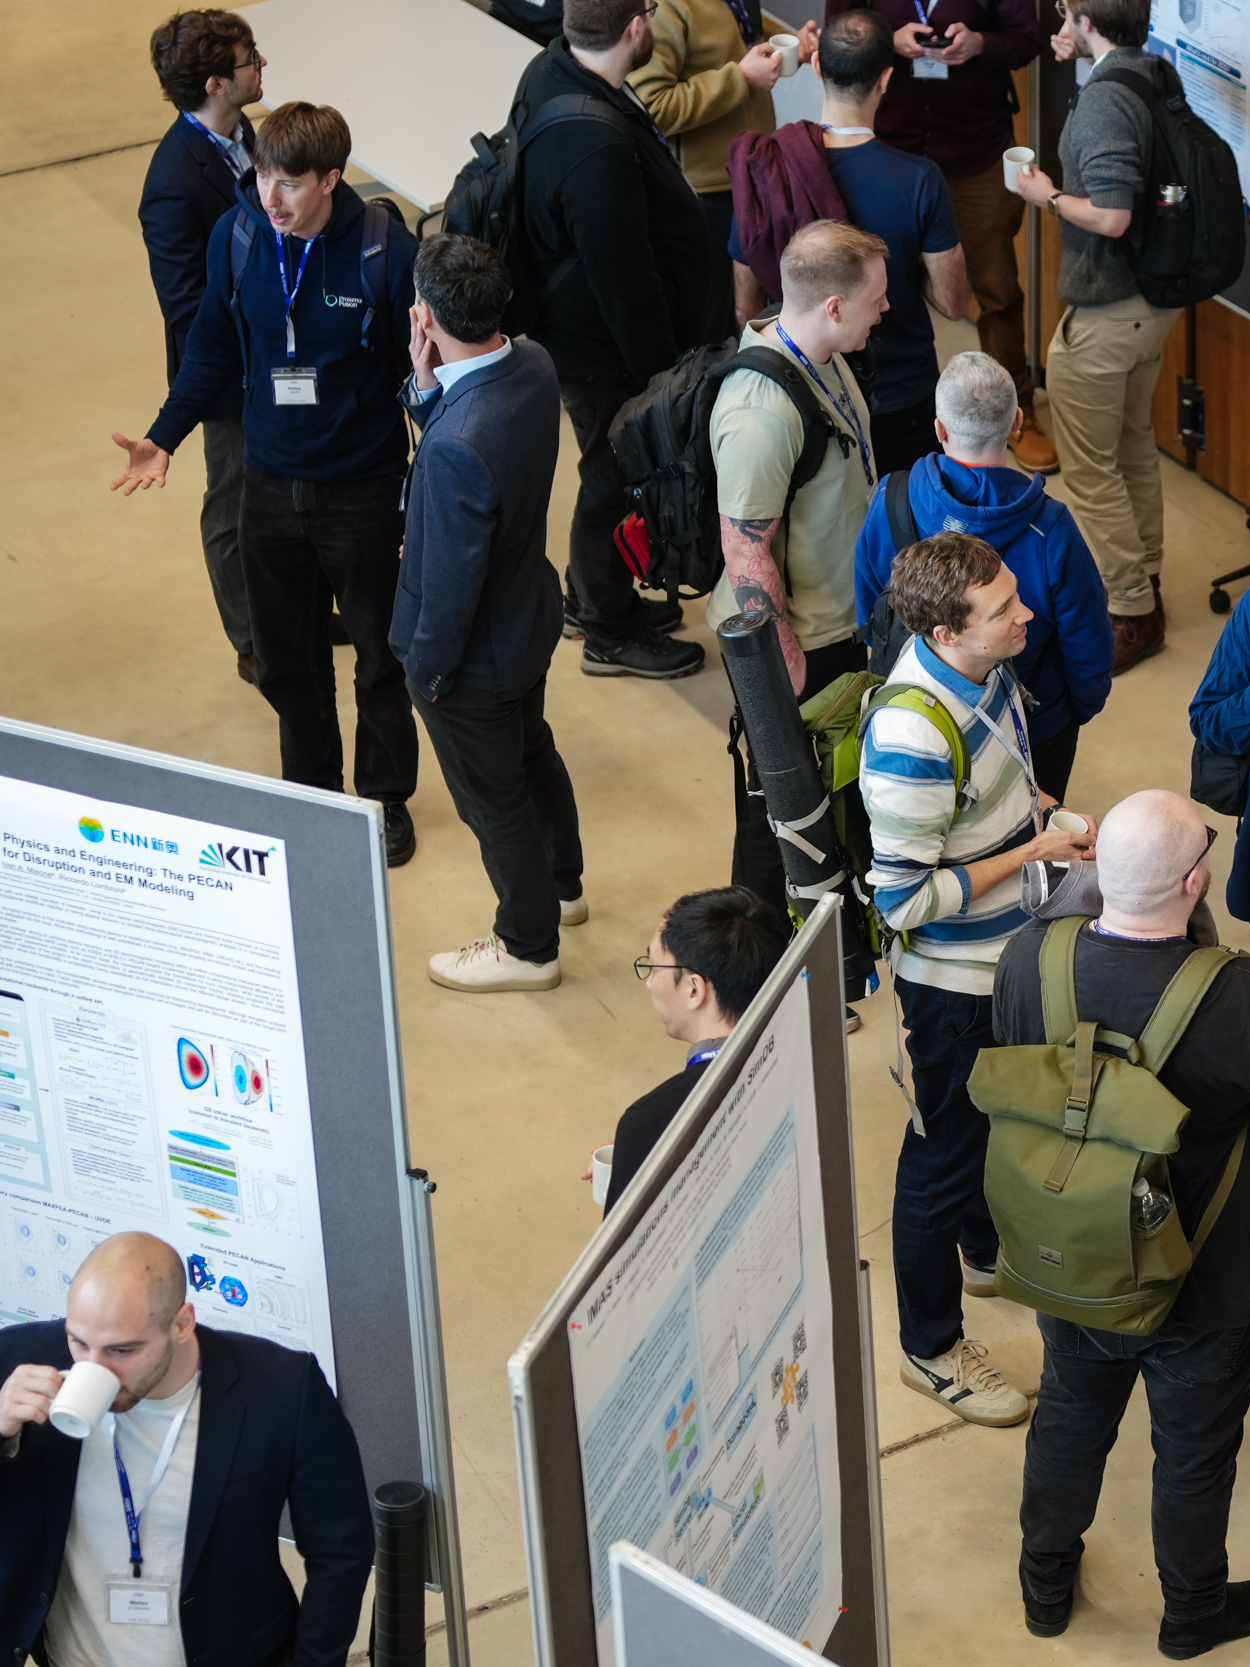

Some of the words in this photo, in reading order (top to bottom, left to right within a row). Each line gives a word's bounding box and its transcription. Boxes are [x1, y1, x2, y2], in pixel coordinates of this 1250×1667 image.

[3, 832, 50, 852] Physics
[54, 846, 76, 858] and
[79, 849, 157, 878] Engineering:
[161, 867, 184, 882] The
[188, 873, 233, 892] PECAN
[110, 829, 149, 848] ENN
[219, 844, 269, 877] KIT
[2, 847, 19, 859] for
[23, 851, 86, 875] Disruption
[89, 868, 112, 881] and
[115, 872, 134, 886] EM
[138, 879, 195, 901] Modeling
[587, 1279, 612, 1327] IMAS
[615, 1201, 668, 1285] simulations
[670, 1110, 728, 1203] management
[728, 1083, 746, 1116] with
[747, 1034, 775, 1086] SimDB
